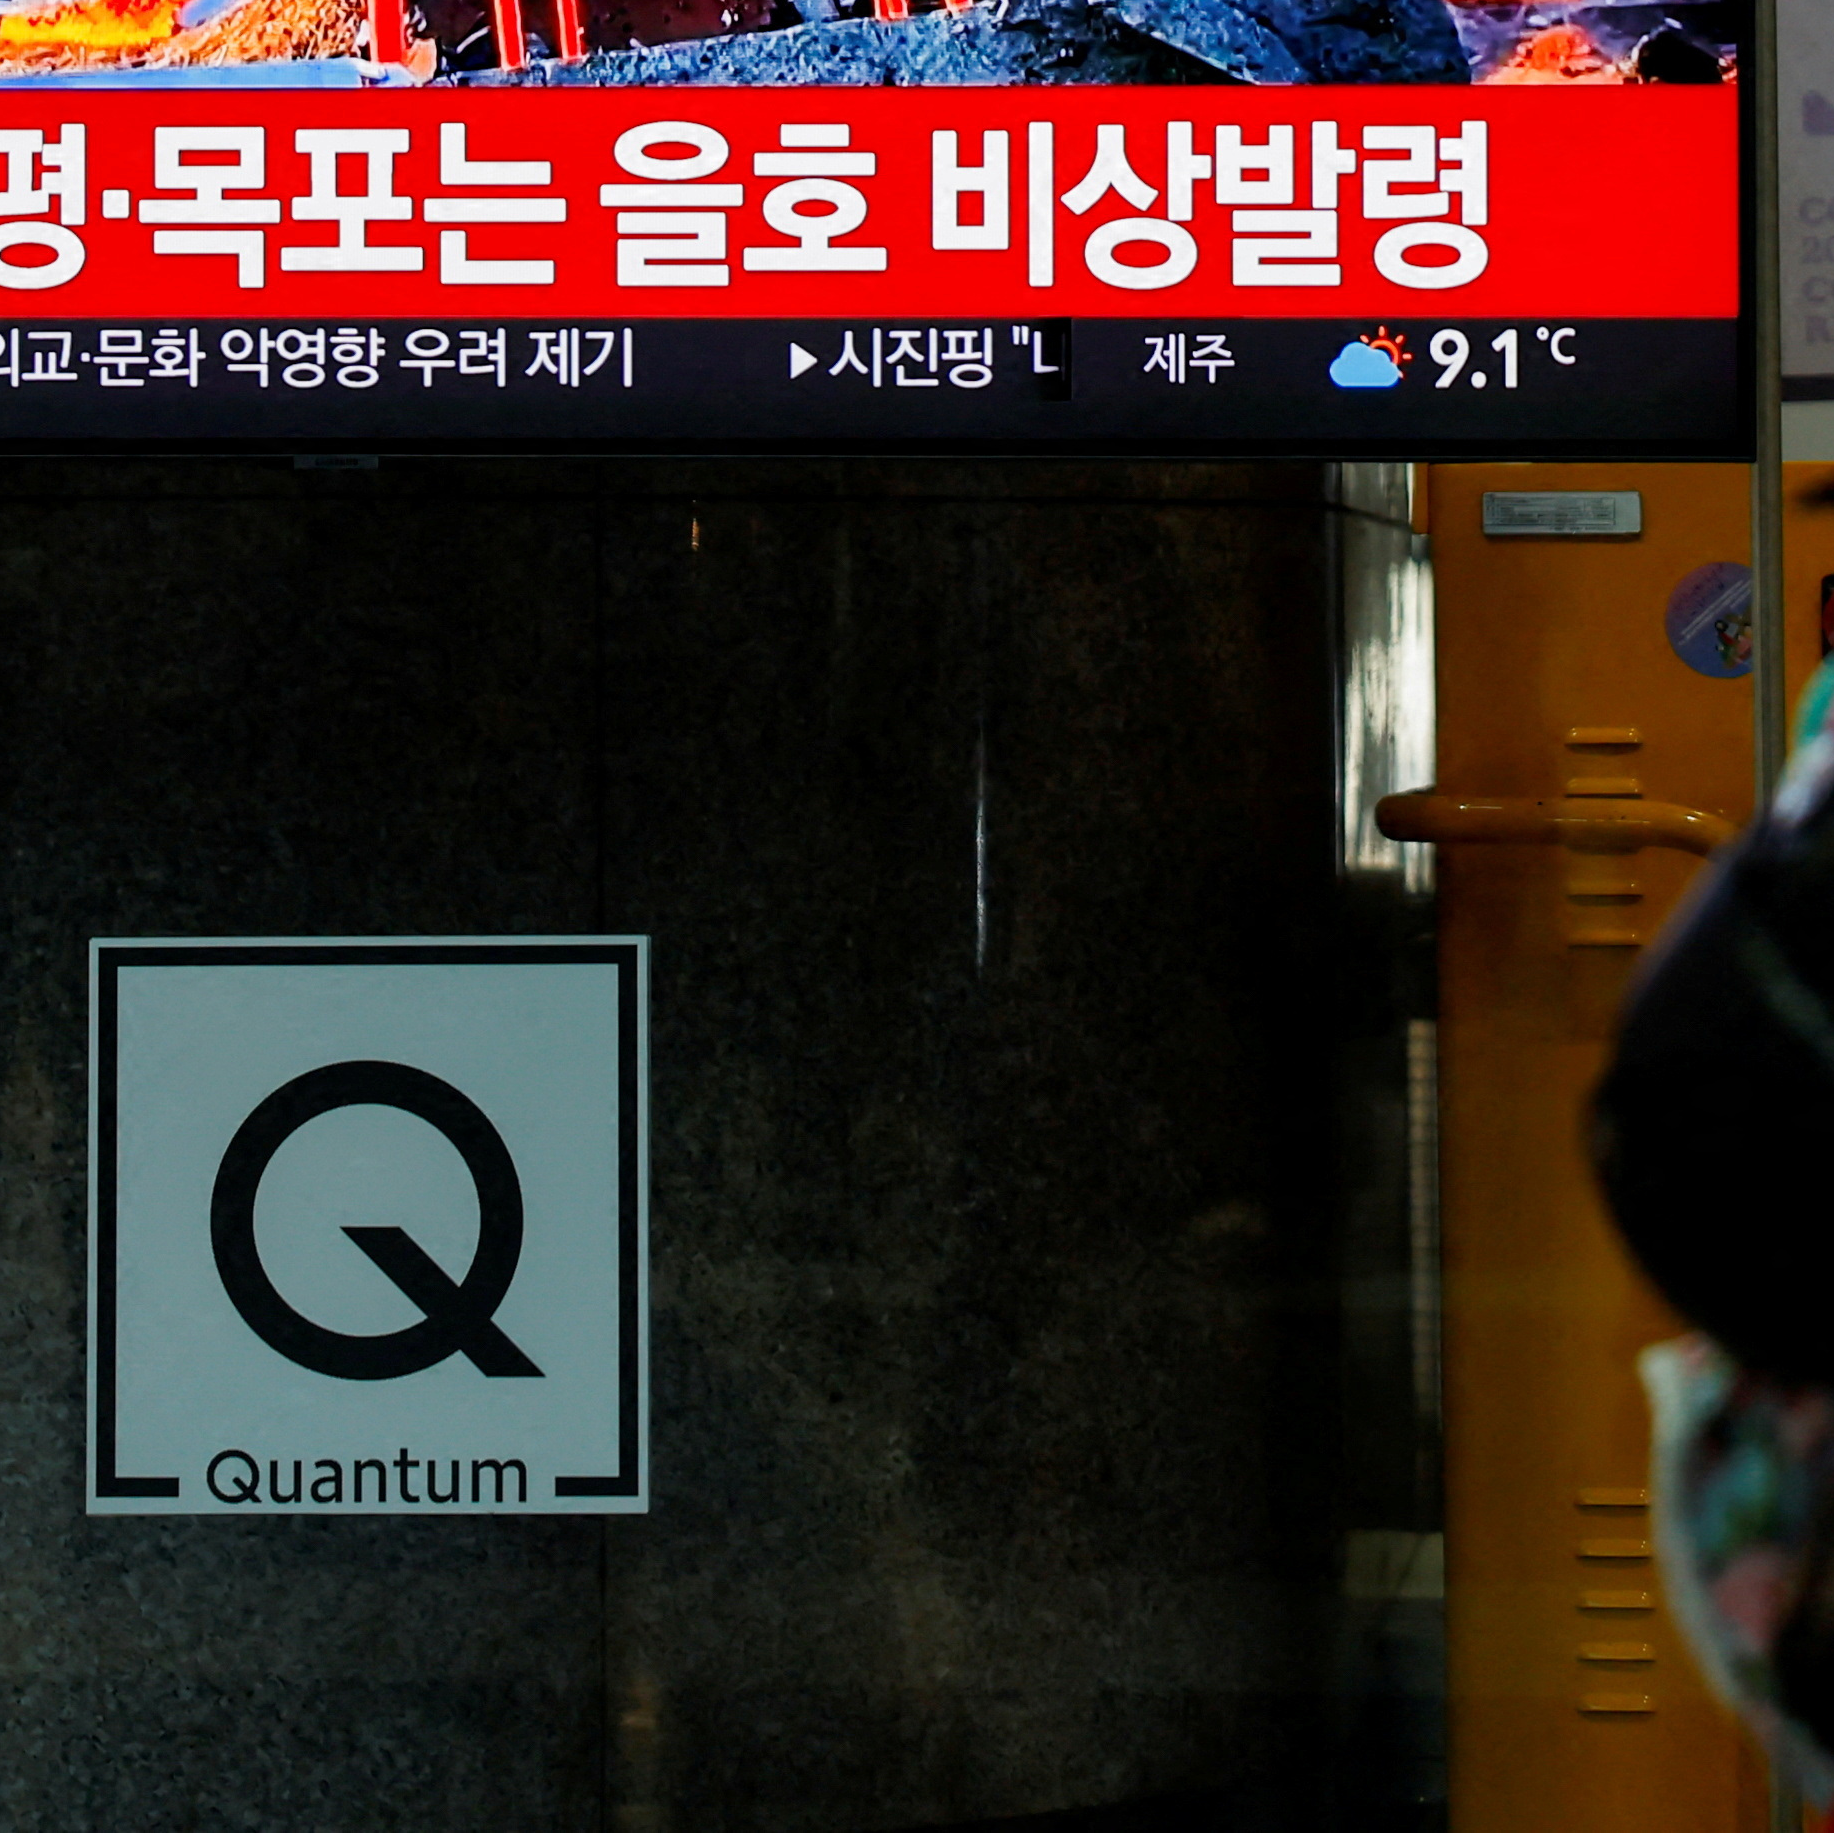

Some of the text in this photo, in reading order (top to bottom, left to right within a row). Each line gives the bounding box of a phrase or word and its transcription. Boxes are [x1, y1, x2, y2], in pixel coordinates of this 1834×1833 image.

[601, 122, 886, 286] 을호
[933, 121, 1487, 289] 비상발령
[221, 329, 385, 387] 악영향
[400, 329, 505, 386] 우려
[526, 328, 631, 386] 제기
[830, 328, 992, 387] 시진핑
[1144, 334, 1234, 383] 제주
[207, 1449, 526, 1503] Quantum
